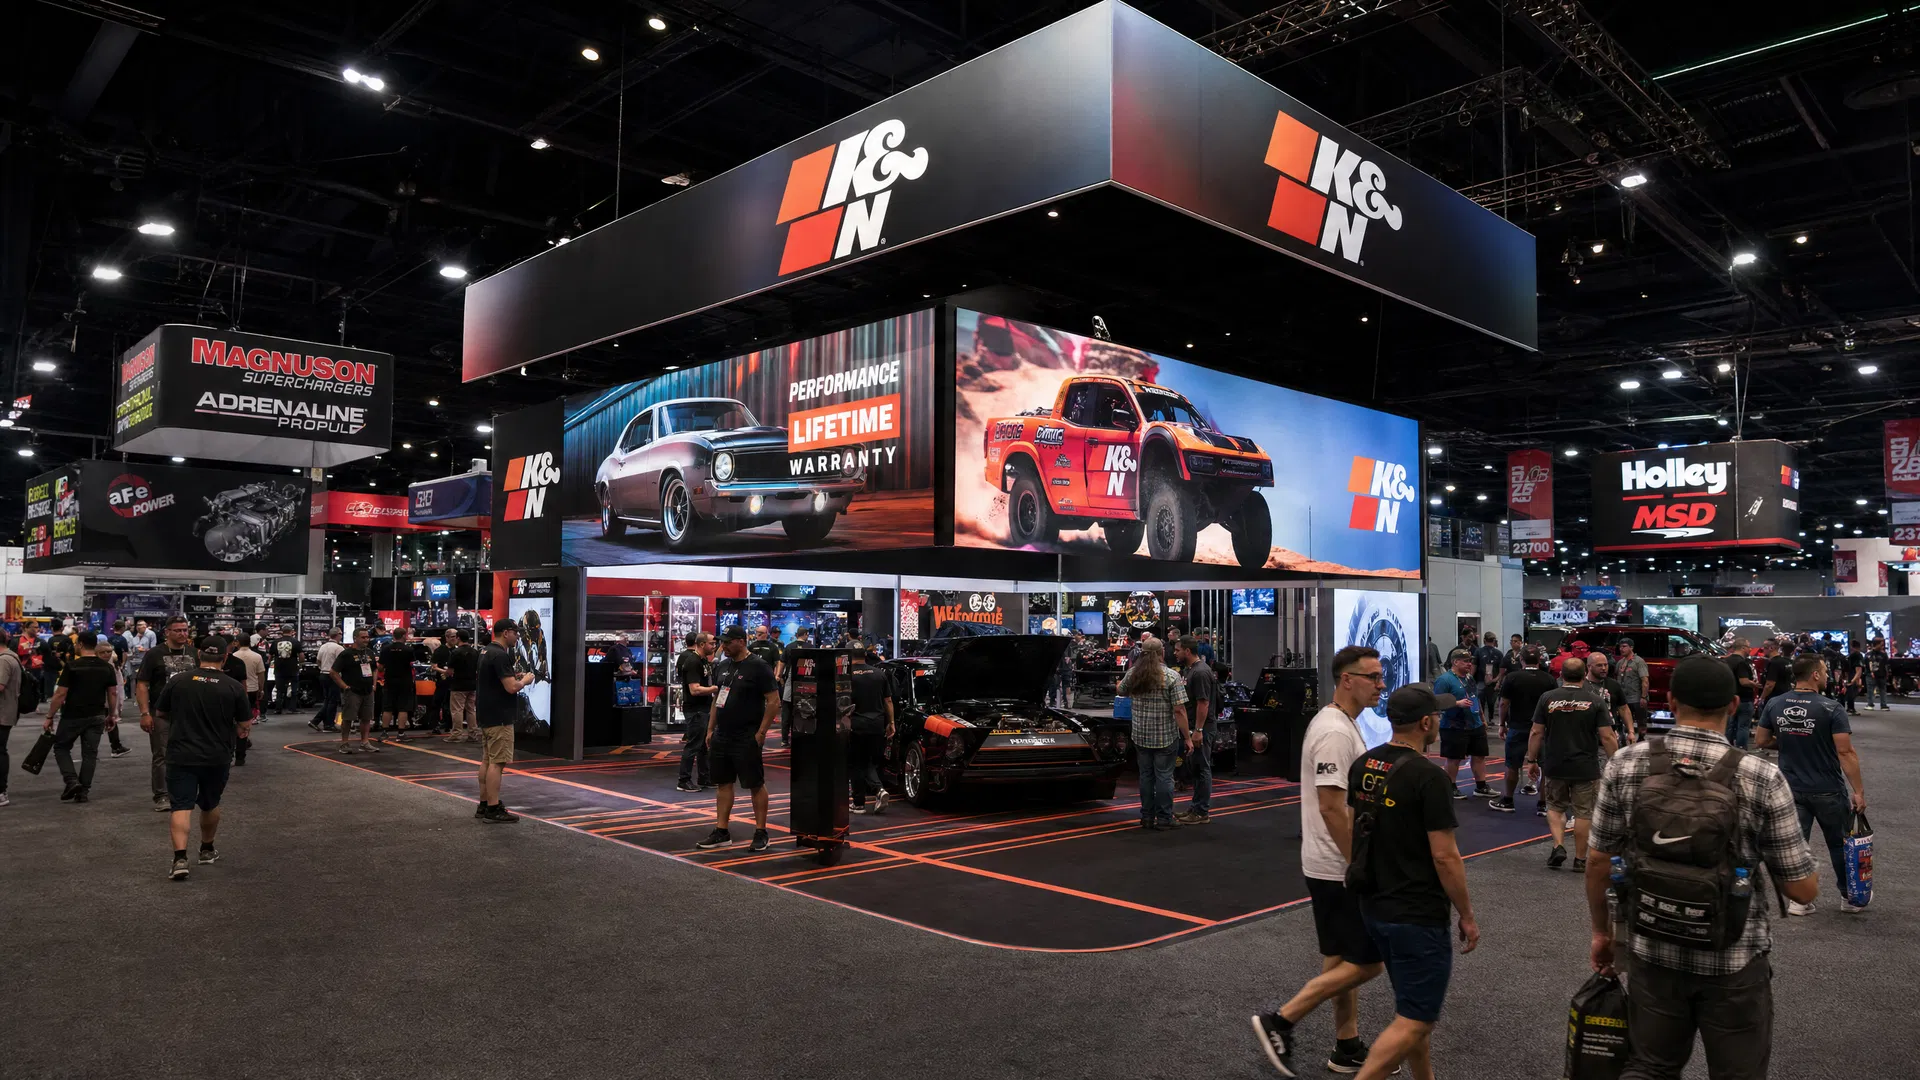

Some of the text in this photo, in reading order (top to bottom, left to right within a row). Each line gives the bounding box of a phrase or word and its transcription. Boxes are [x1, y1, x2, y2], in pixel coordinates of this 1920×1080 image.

[822, 119, 929, 210] K&
[1310, 135, 1403, 231] K&
[834, 189, 892, 260] N
[1319, 200, 1369, 264] N
[191, 337, 376, 386] MAGNUSON
[242, 371, 374, 397] SUPERCHARGERS
[788, 359, 901, 403] PERFORMANCE
[196, 391, 366, 424] ADRENALINE
[793, 403, 893, 445] LIFETIME
[520, 451, 561, 489] K&
[789, 446, 897, 476] WARRANTY
[1103, 444, 1137, 473] K&
[1621, 457, 1728, 495] Holley
[109, 484, 149, 506] aFe
[1106, 471, 1126, 497] N
[1370, 459, 1415, 503] K&
[132, 493, 176, 517] POWER
[523, 486, 547, 520] N
[1375, 498, 1401, 534] N
[1632, 502, 1717, 530] MSD
[1512, 541, 1550, 554] 23700
